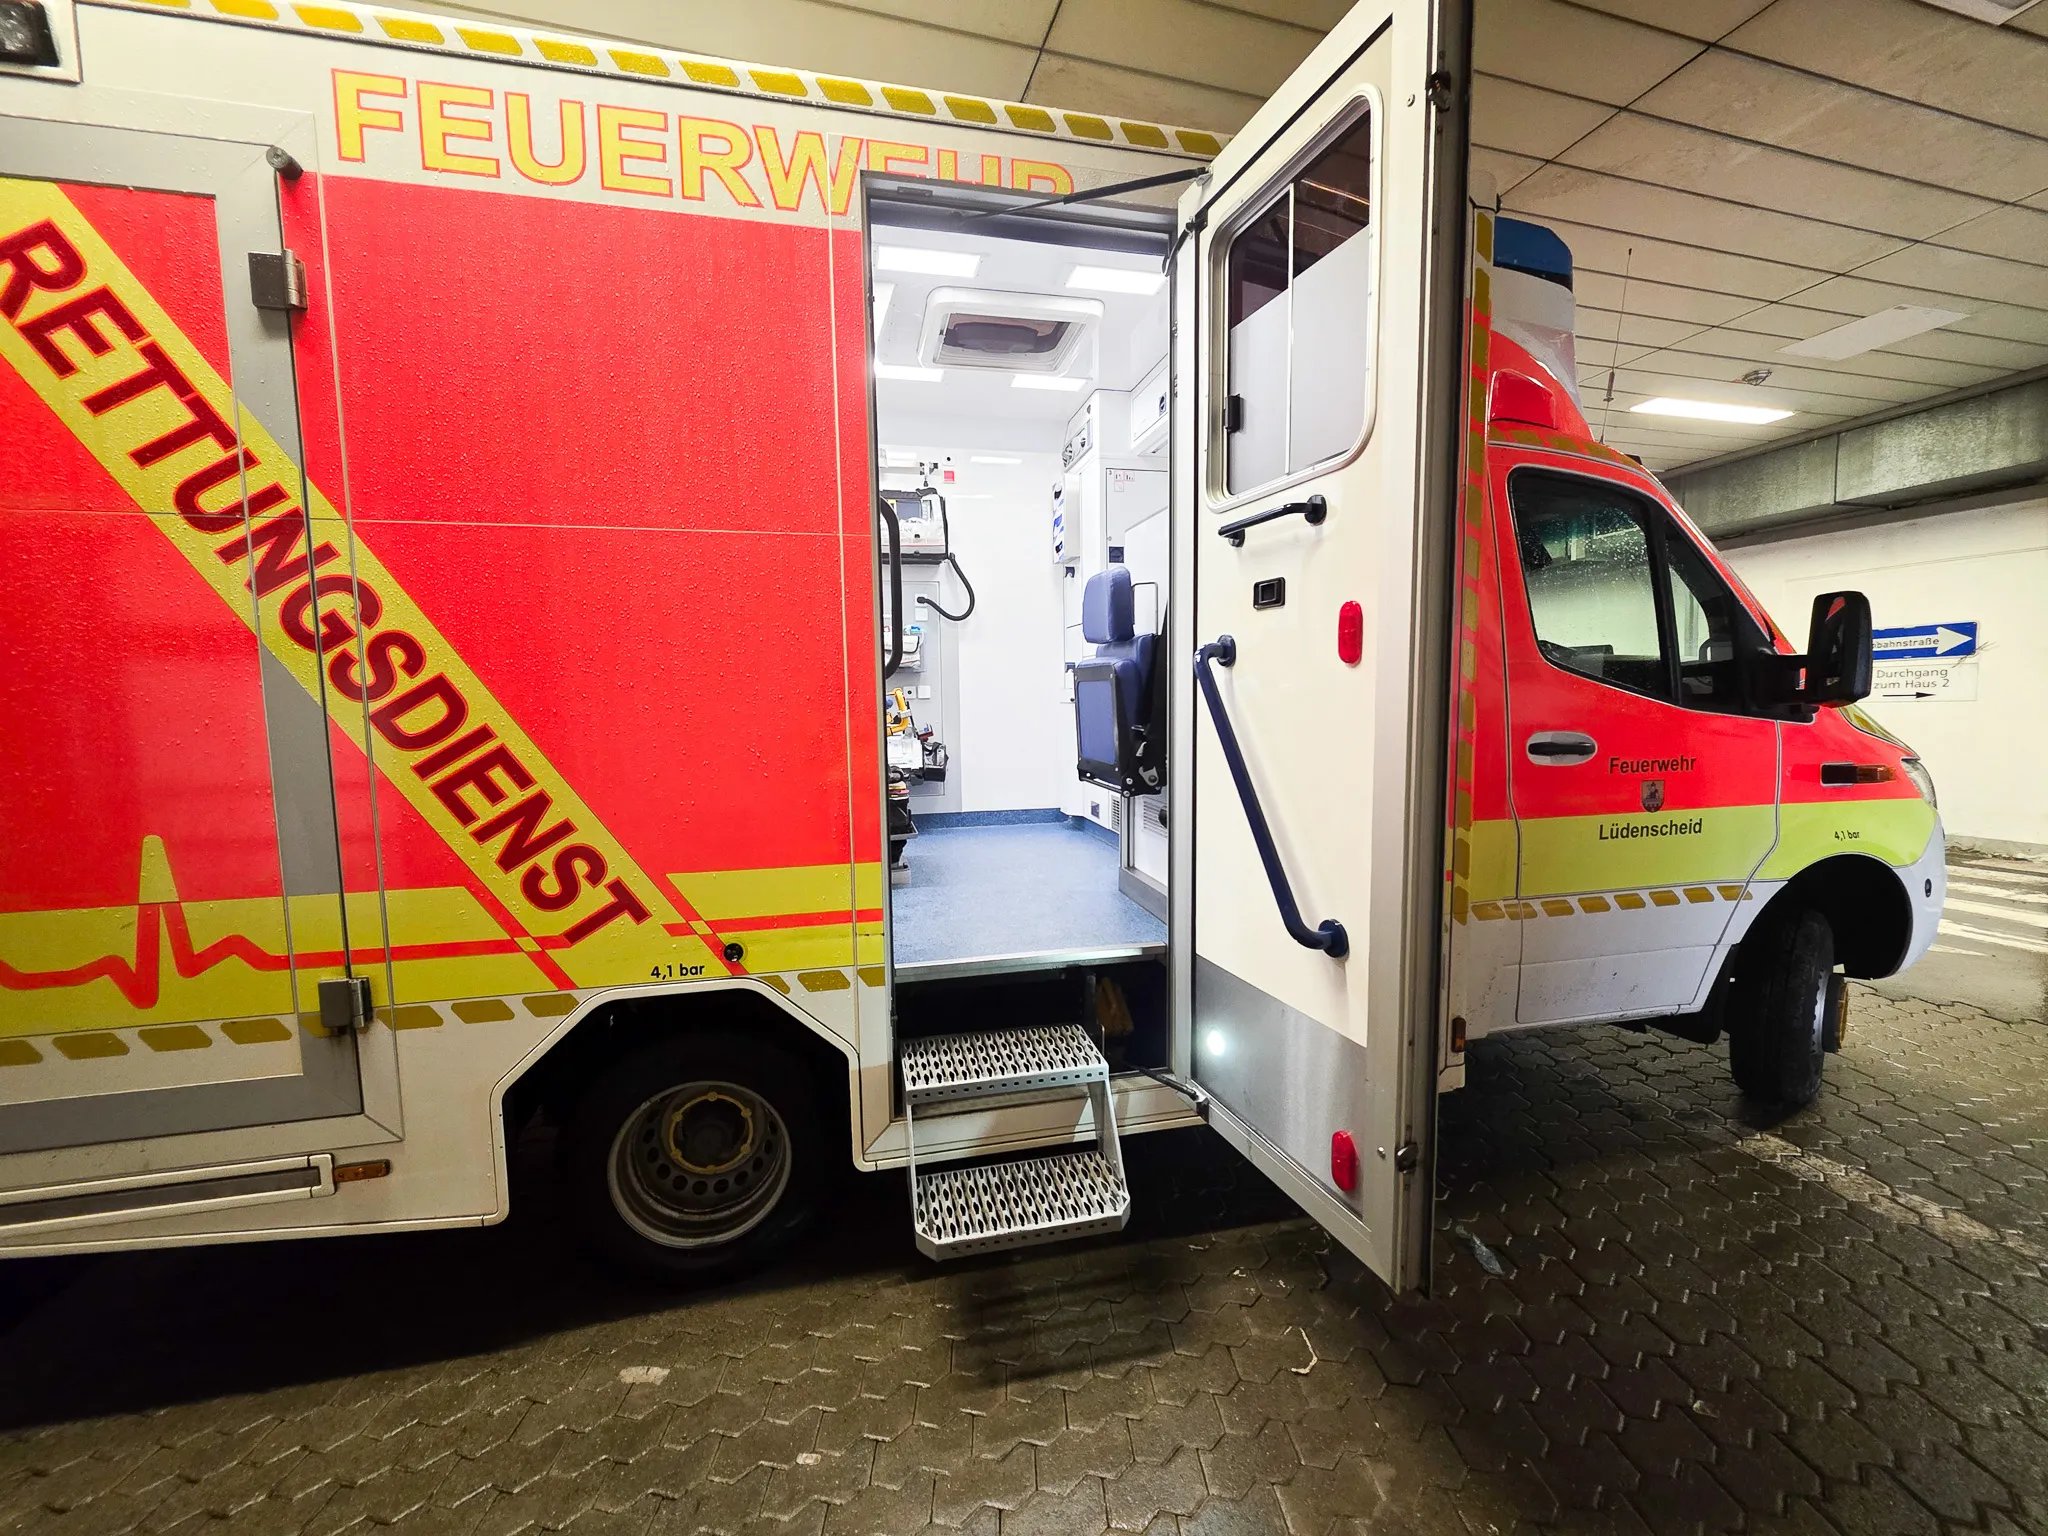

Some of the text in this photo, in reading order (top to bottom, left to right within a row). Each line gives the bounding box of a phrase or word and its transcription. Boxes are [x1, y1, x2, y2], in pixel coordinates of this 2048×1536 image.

[0, 216, 653, 948] RETTUNGSDIENST
[1877, 668, 1948, 679] Durchgang
[1873, 678, 1950, 689] zum Haus 2
[1609, 755, 1697, 774] Feuerwehr
[1599, 818, 1703, 841] Lüdenscheid
[1834, 829, 1860, 841] 4,1 bar
[650, 963, 705, 981] 4,1 bar
